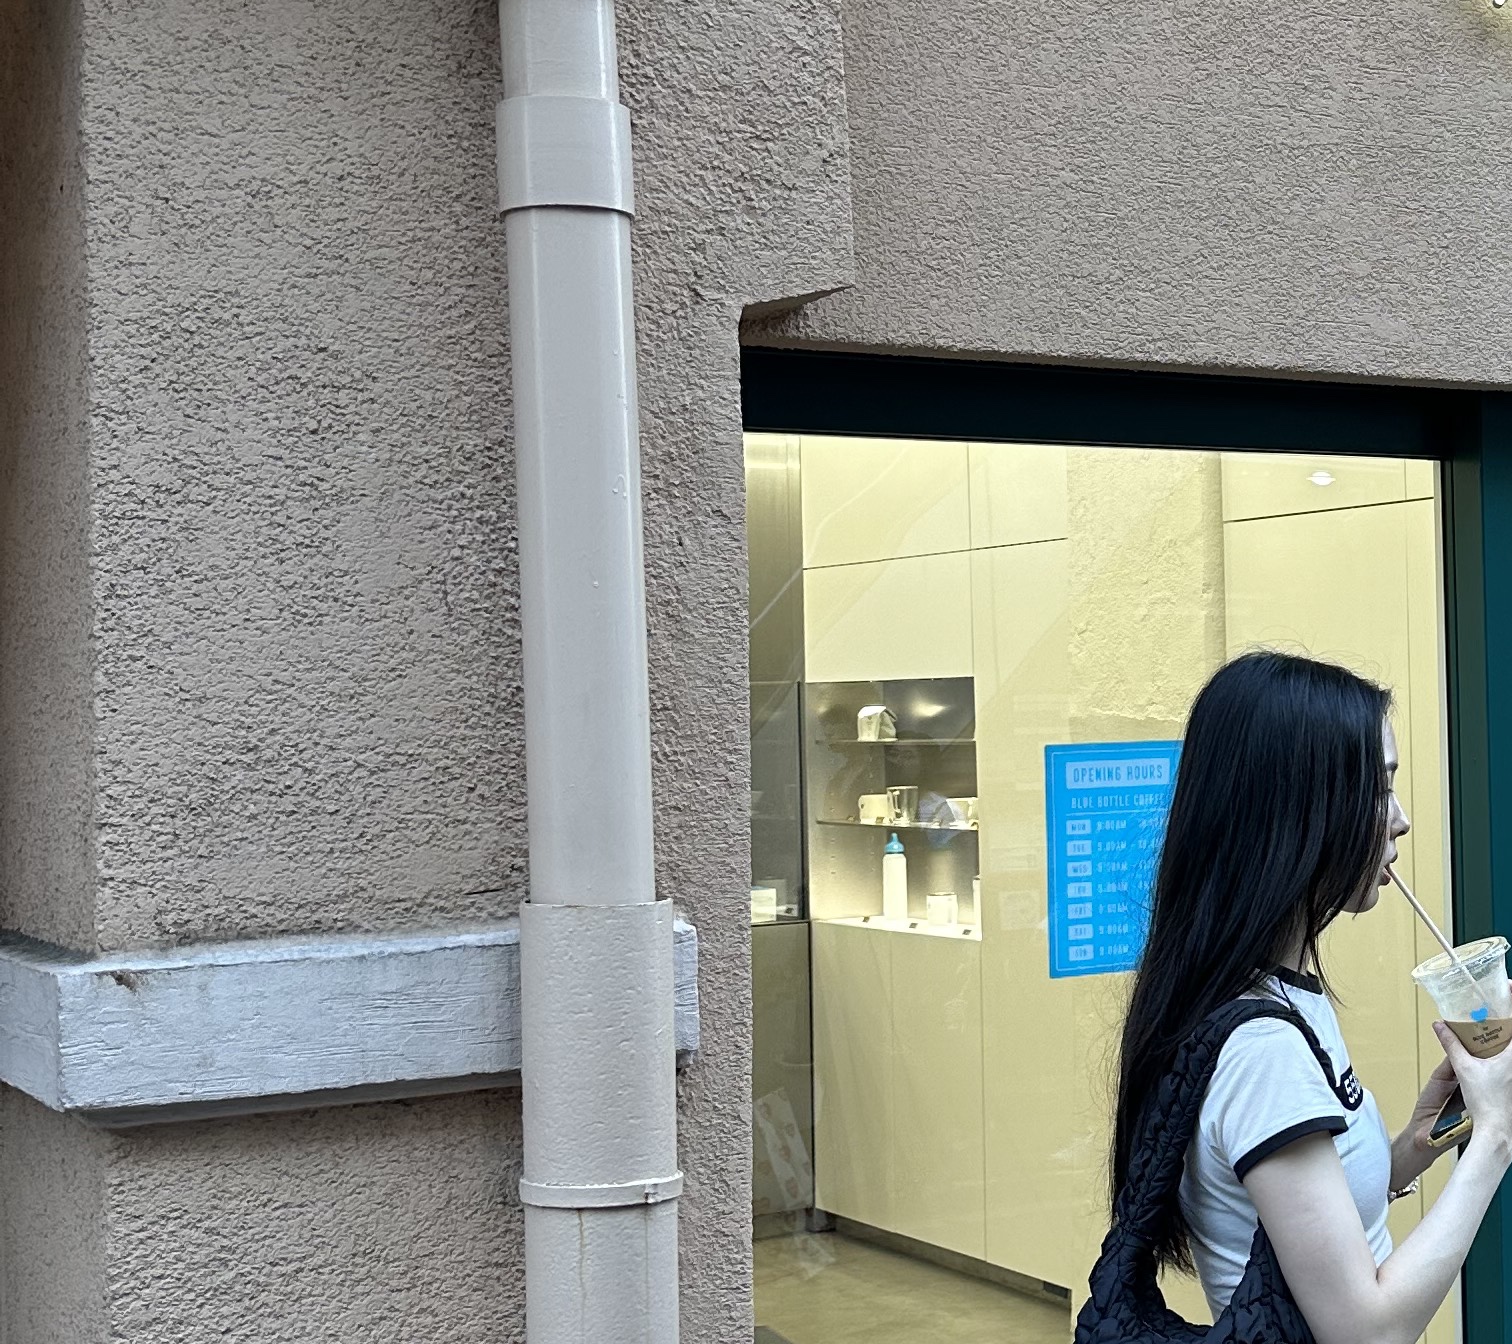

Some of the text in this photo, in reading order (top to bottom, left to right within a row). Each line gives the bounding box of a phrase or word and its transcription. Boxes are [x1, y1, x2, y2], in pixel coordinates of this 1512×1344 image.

[1073, 764, 1163, 783] OPENING HOURS
[1071, 796, 1094, 809] BLUE
[1097, 794, 1130, 808] BOTTLE
